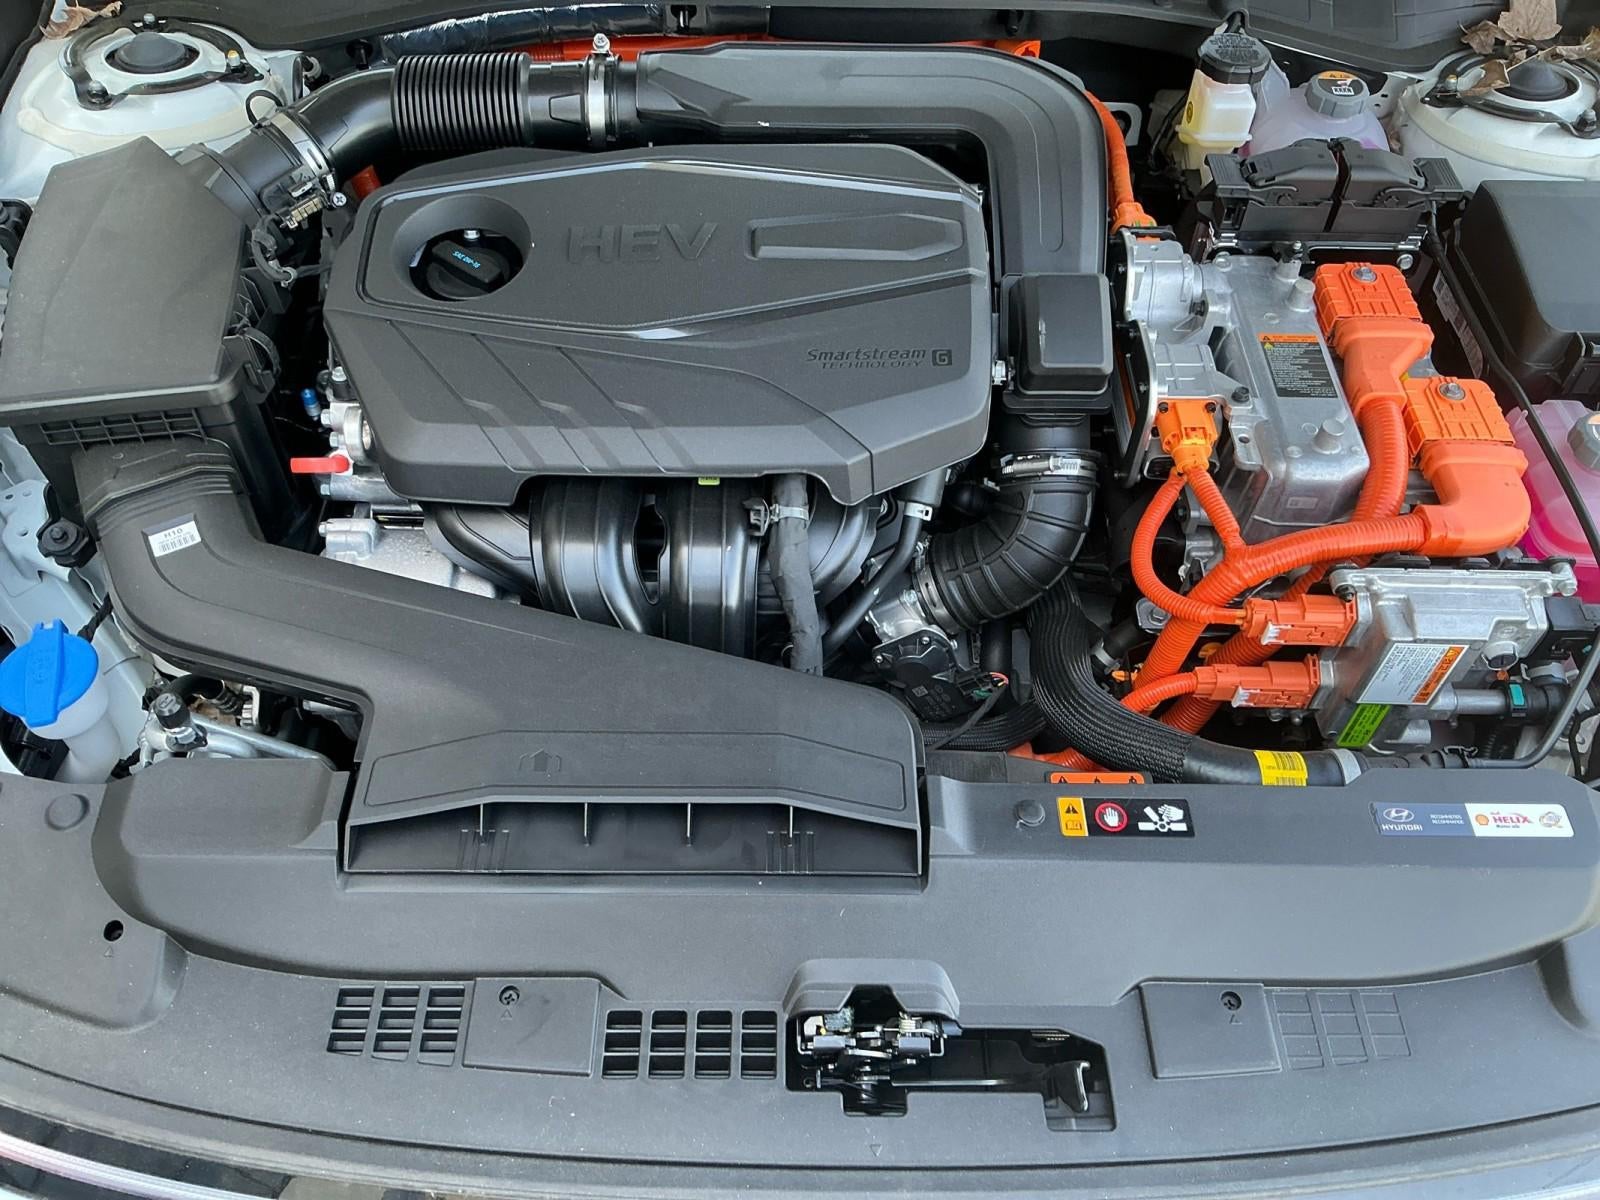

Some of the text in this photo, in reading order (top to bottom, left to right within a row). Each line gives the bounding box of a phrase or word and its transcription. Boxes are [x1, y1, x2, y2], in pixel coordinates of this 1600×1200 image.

[567, 222, 719, 264] HEV
[806, 348, 926, 362] Smartstream
[1492, 815, 1530, 824] HELIX
[1382, 823, 1423, 831] HYUNDAI
